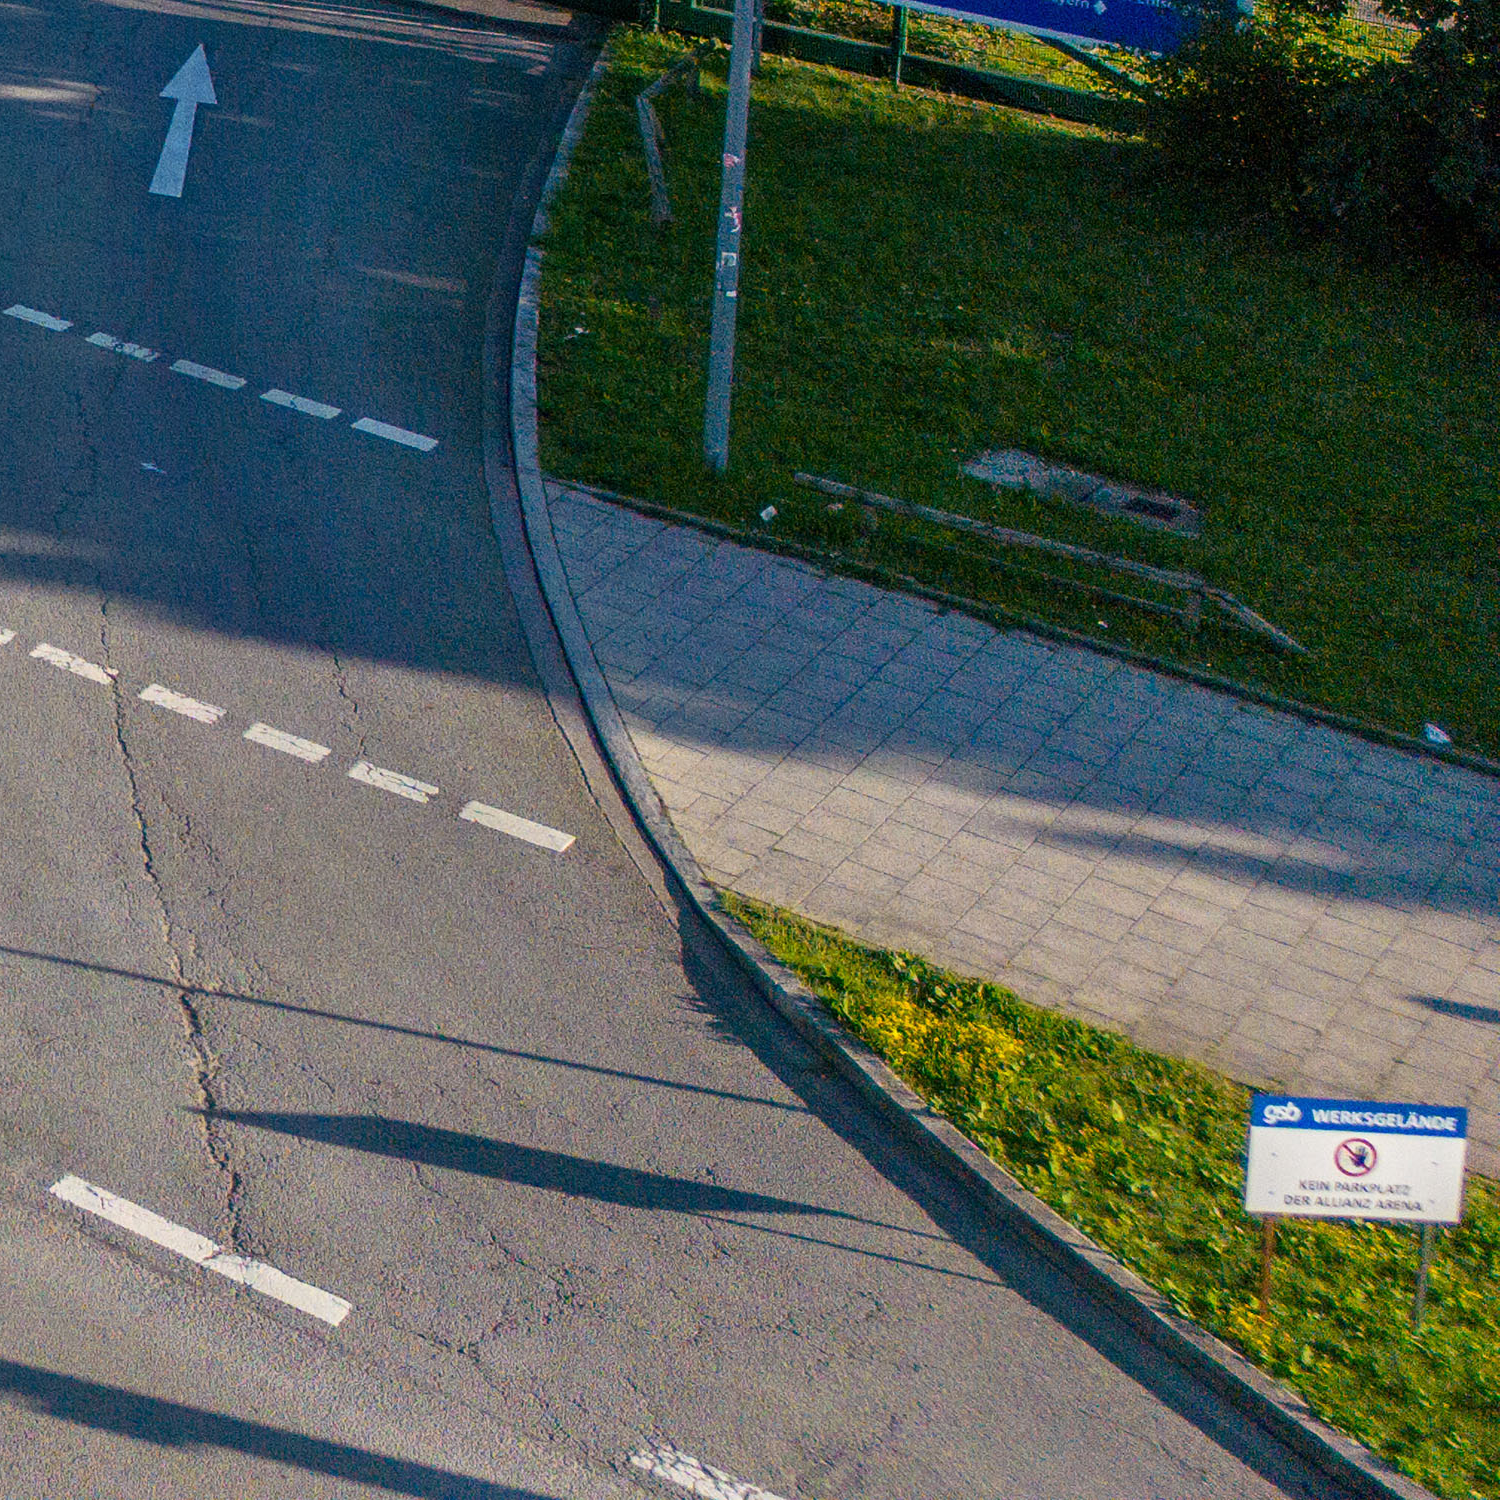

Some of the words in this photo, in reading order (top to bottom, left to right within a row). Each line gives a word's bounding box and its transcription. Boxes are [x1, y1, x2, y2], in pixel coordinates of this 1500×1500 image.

[1263, 1102, 1302, 1124] gsb
[1312, 1108, 1459, 1131] WERKSGELÄNDE
[1298, 1179, 1330, 1191] KEIN
[1284, 1194, 1310, 1206] DER
